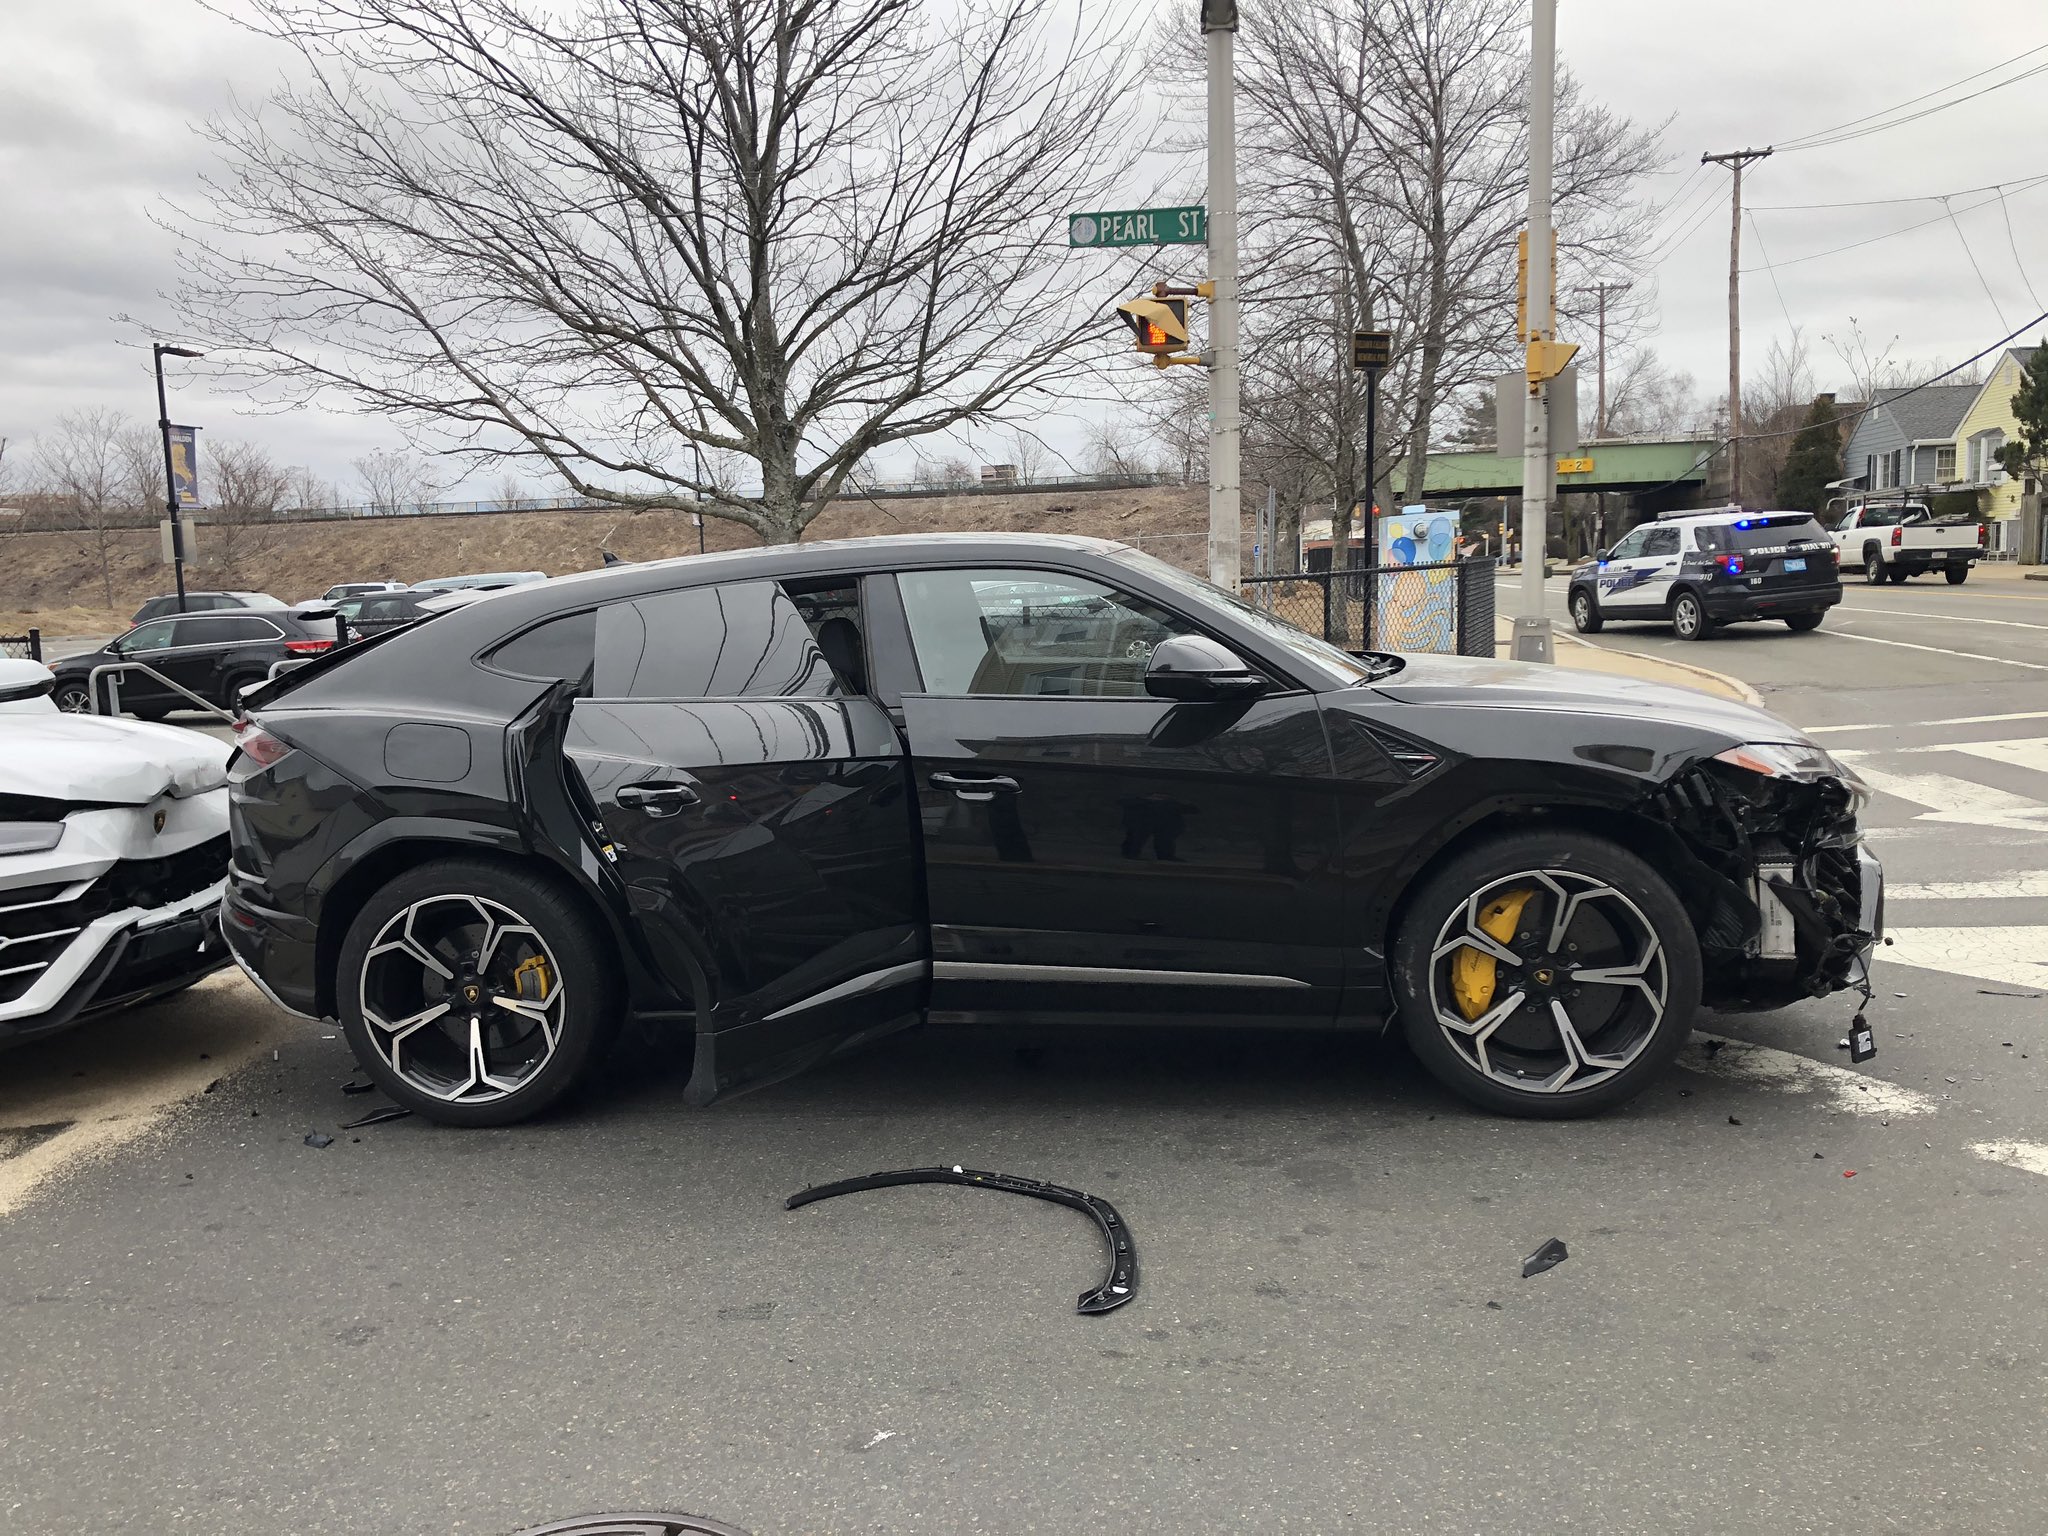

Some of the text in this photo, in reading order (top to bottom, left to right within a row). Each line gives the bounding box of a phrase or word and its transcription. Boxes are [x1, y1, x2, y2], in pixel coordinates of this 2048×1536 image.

[1101, 215, 1159, 242] PEARL
[1179, 211, 1200, 237] ST
[1750, 546, 1786, 555] POLICE
[1801, 543, 1819, 551] DIAL
[1600, 578, 1634, 588] POLICE
